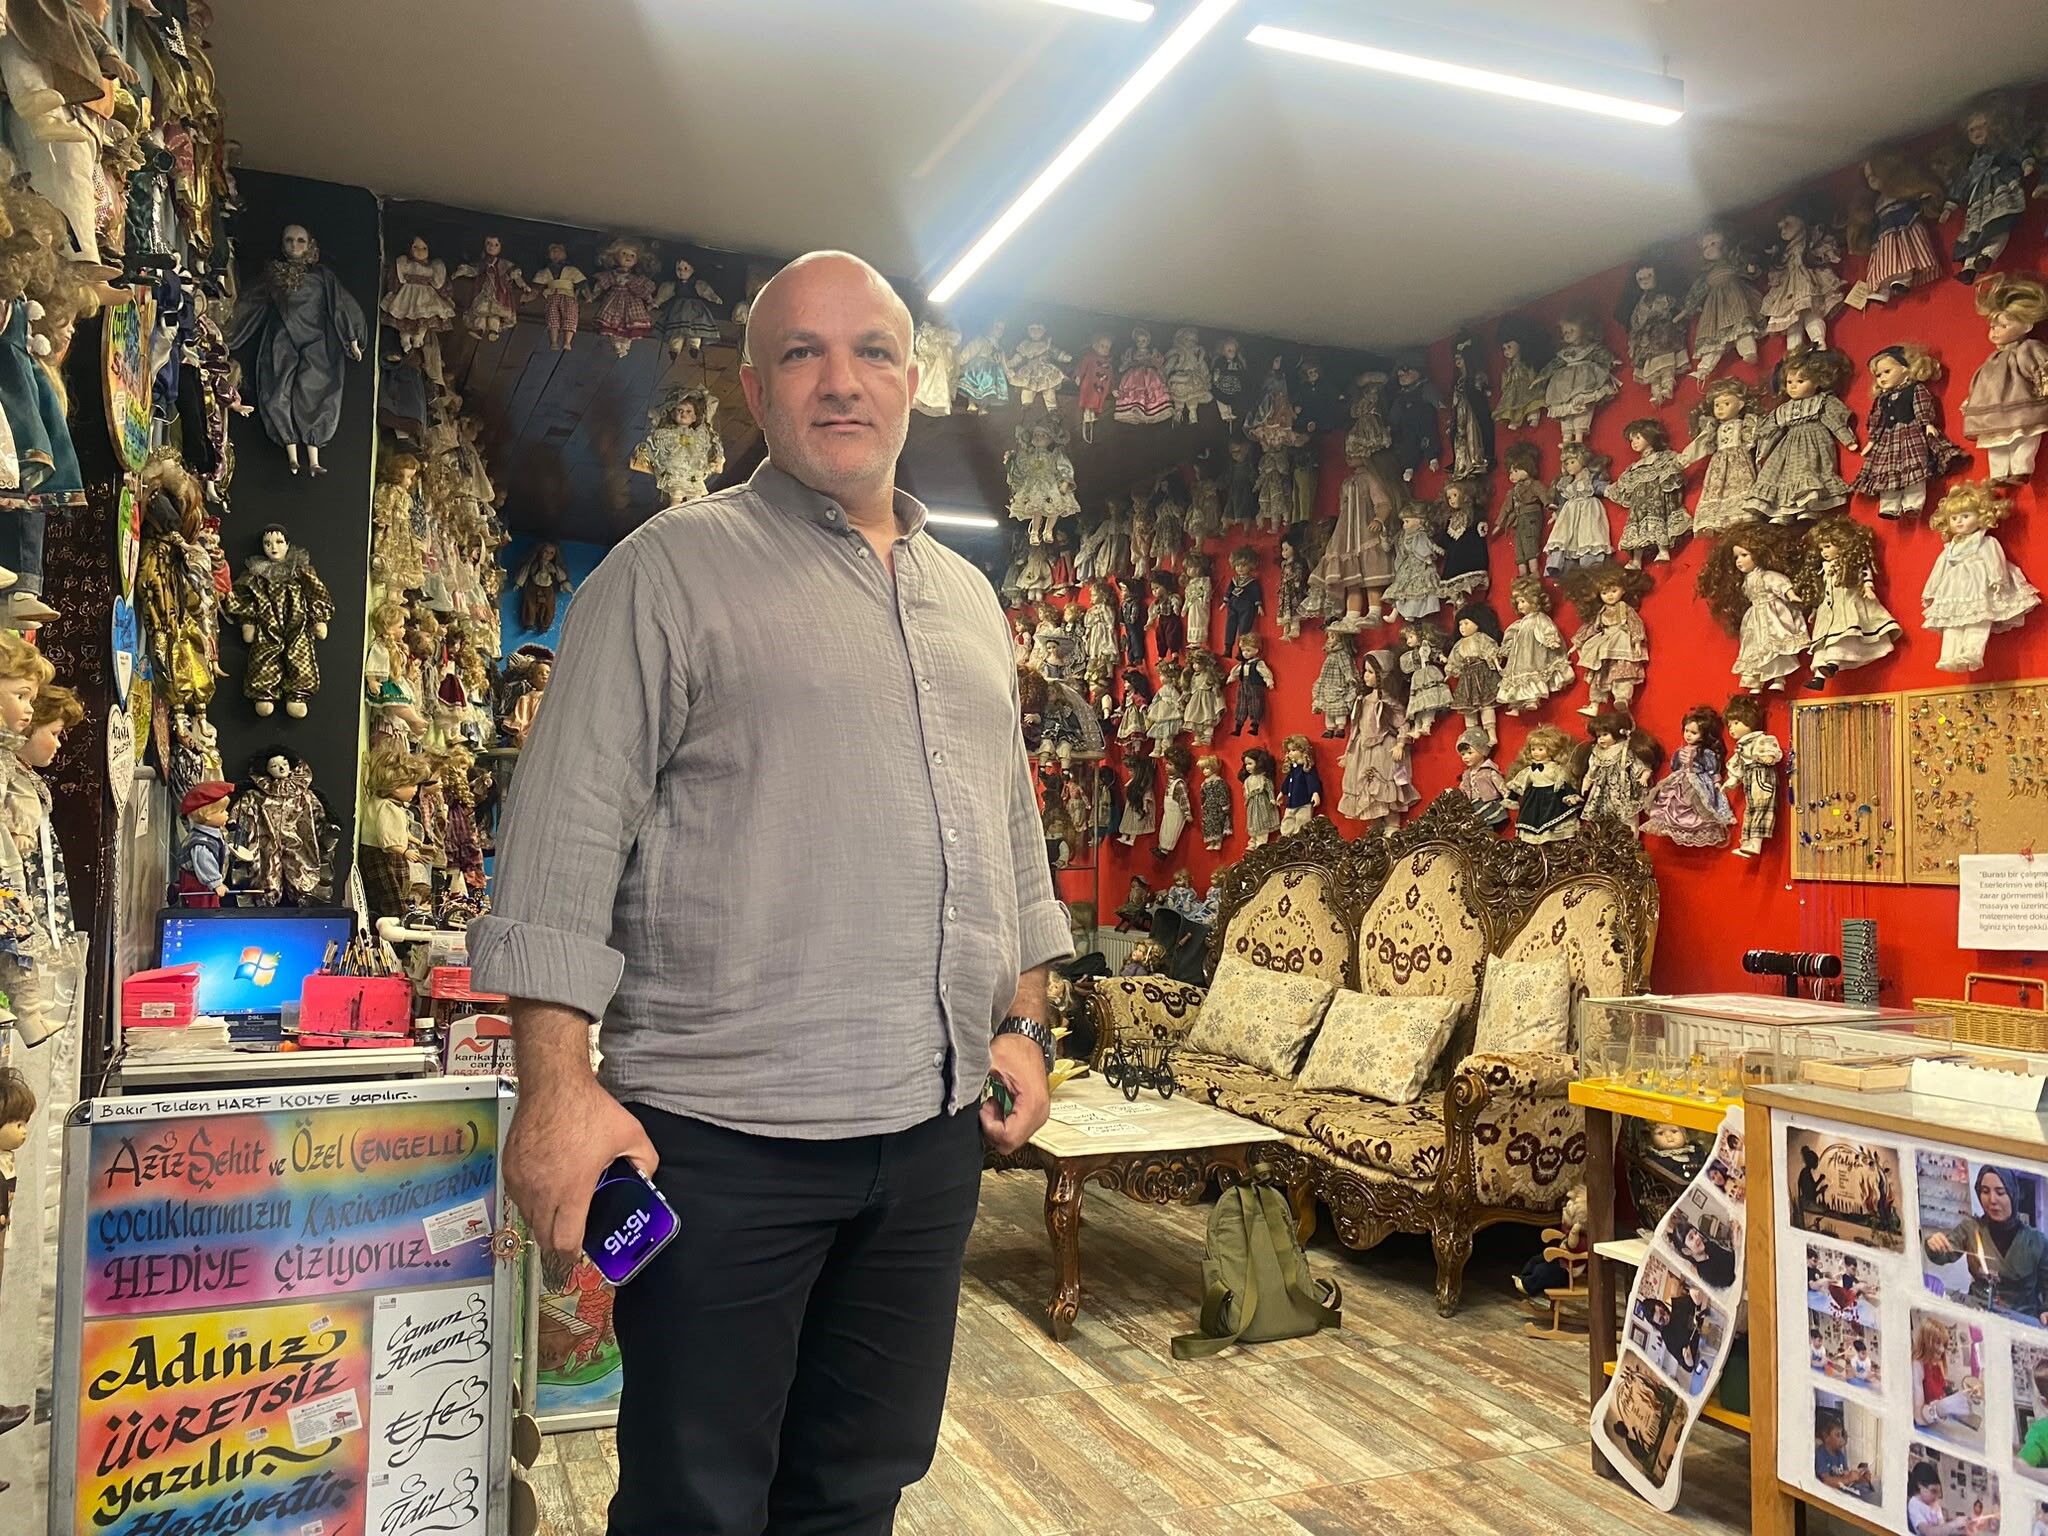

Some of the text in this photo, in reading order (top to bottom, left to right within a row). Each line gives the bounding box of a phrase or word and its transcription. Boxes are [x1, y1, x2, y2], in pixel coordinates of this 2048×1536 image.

[2001, 891, 2044, 900] görmemesi
[100, 1104, 147, 1118] Bakır
[152, 1099, 210, 1113] Telden
[217, 1096, 271, 1110] HARF
[280, 1093, 341, 1108] KOLYE
[188, 1126, 265, 1192] Şehit
[268, 1158, 287, 1176] ve
[292, 1118, 345, 1173] Özel
[604, 1208, 650, 1255] 15:15
[103, 1245, 251, 1300] HEDİYE
[88, 1330, 347, 1400] Adınız
[96, 1359, 350, 1477] ÜCRETSİZ
